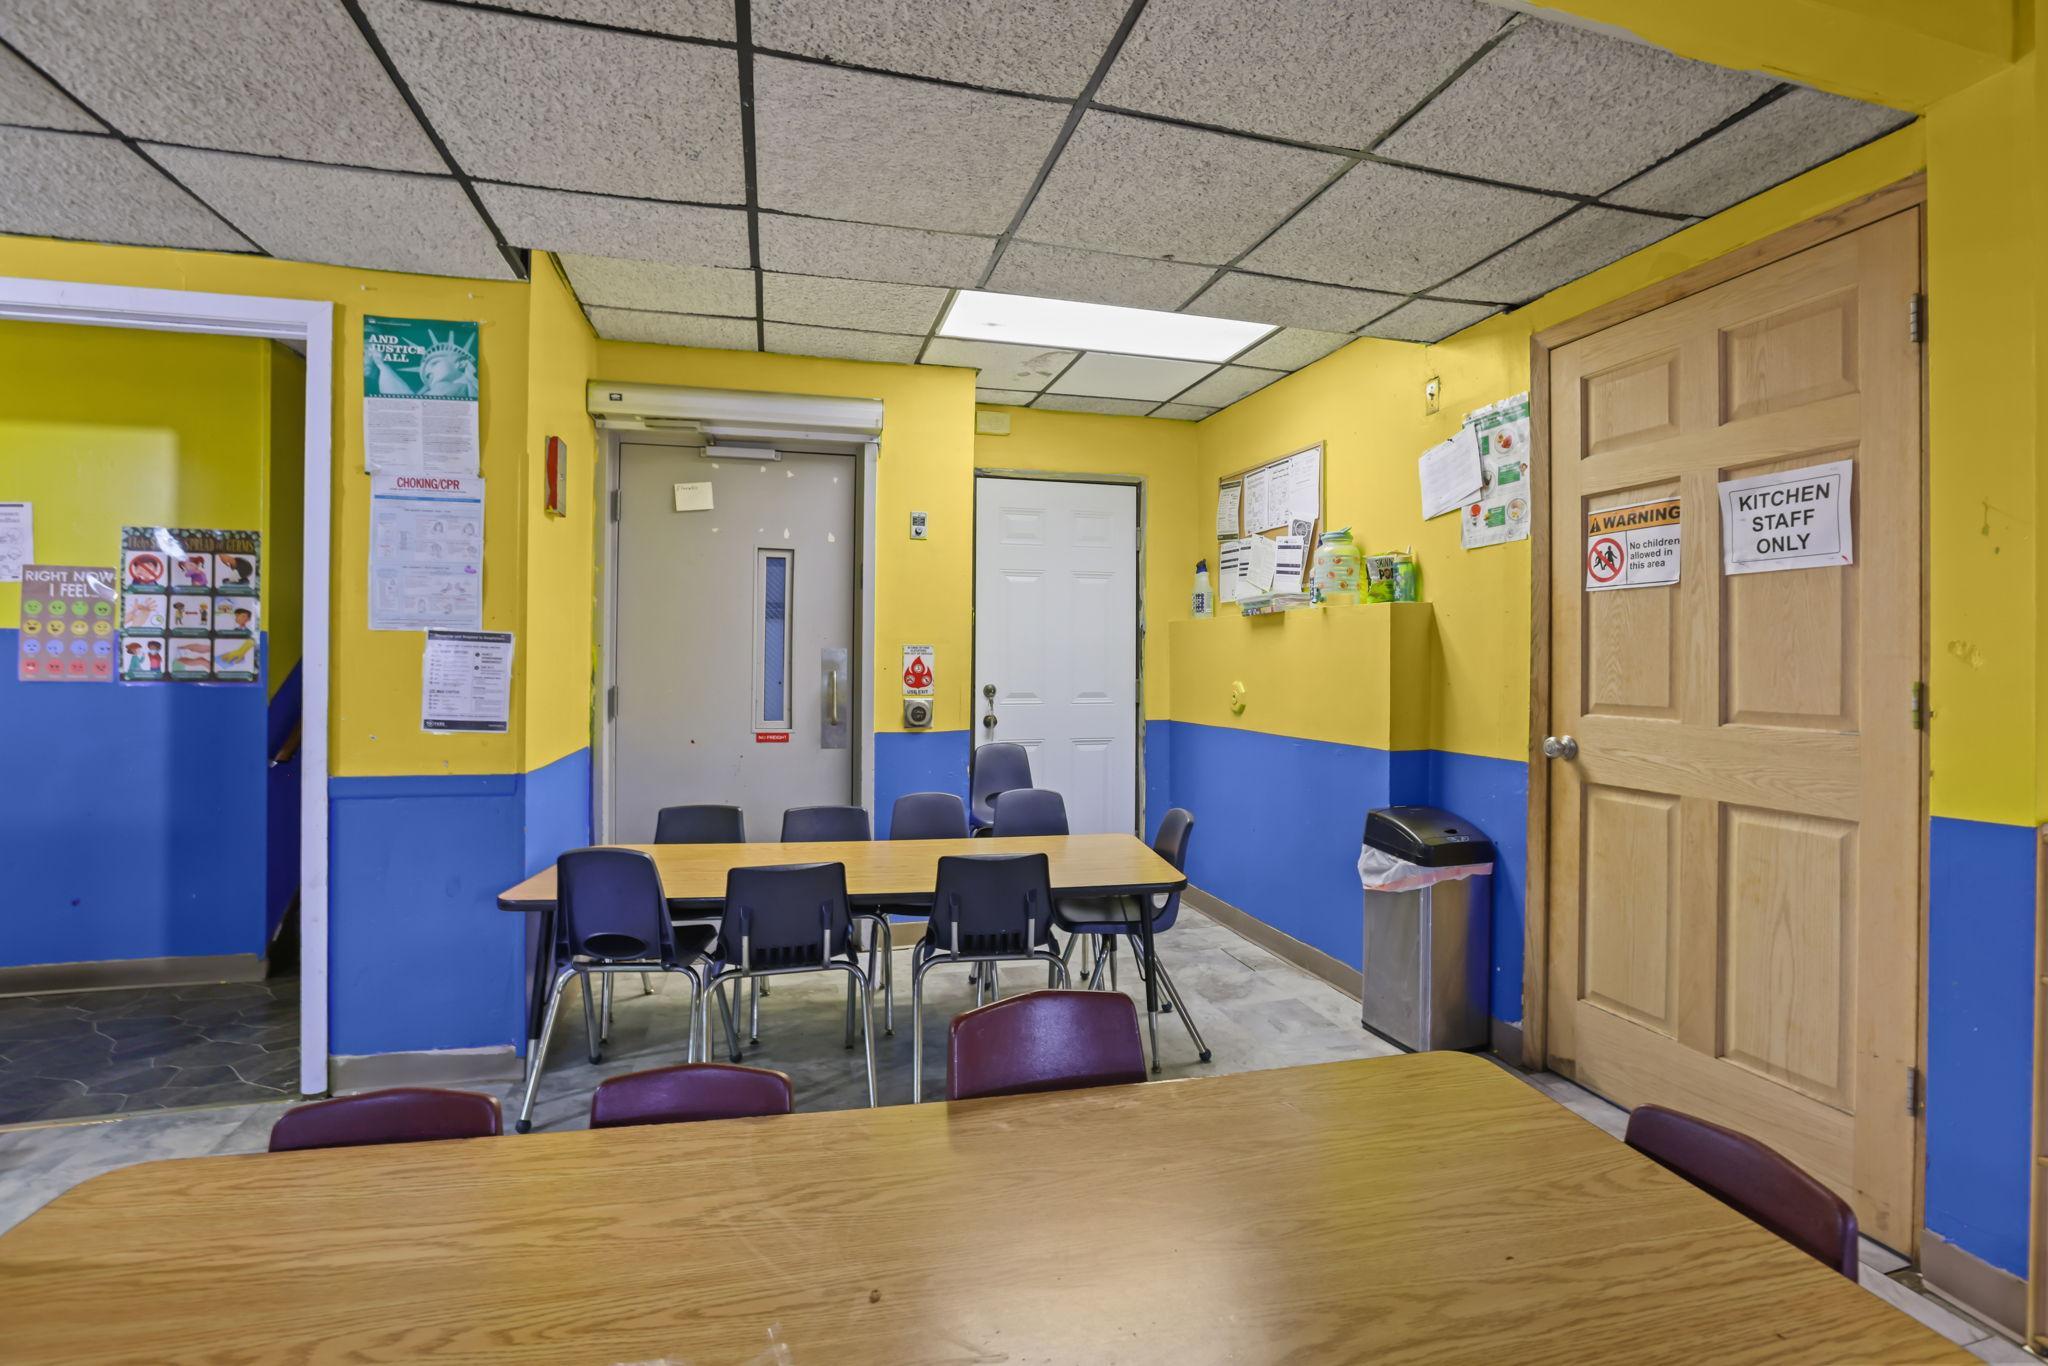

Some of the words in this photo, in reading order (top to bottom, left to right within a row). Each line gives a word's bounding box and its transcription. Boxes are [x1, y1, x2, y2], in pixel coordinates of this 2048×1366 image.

[368, 334, 398, 344] AND
[369, 344, 426, 355] JUSTICE
[384, 353, 409, 362] ALL
[396, 477, 460, 490] CHOKING/CPR
[1739, 482, 1830, 511] KITCHEN
[1603, 506, 1680, 529] WARNING
[1752, 509, 1815, 532] STAFF
[1629, 542, 1640, 550] No
[1643, 538, 1680, 549] children
[1756, 533, 1811, 554] ONLY
[1630, 550, 1661, 560] allowed
[1375, 557, 1394, 568] SKINN
[1629, 562, 1645, 570] this
[1647, 560, 1666, 568] area
[25, 570, 68, 582] RIGHT
[73, 571, 114, 583] NOW
[49, 583, 54, 597] I
